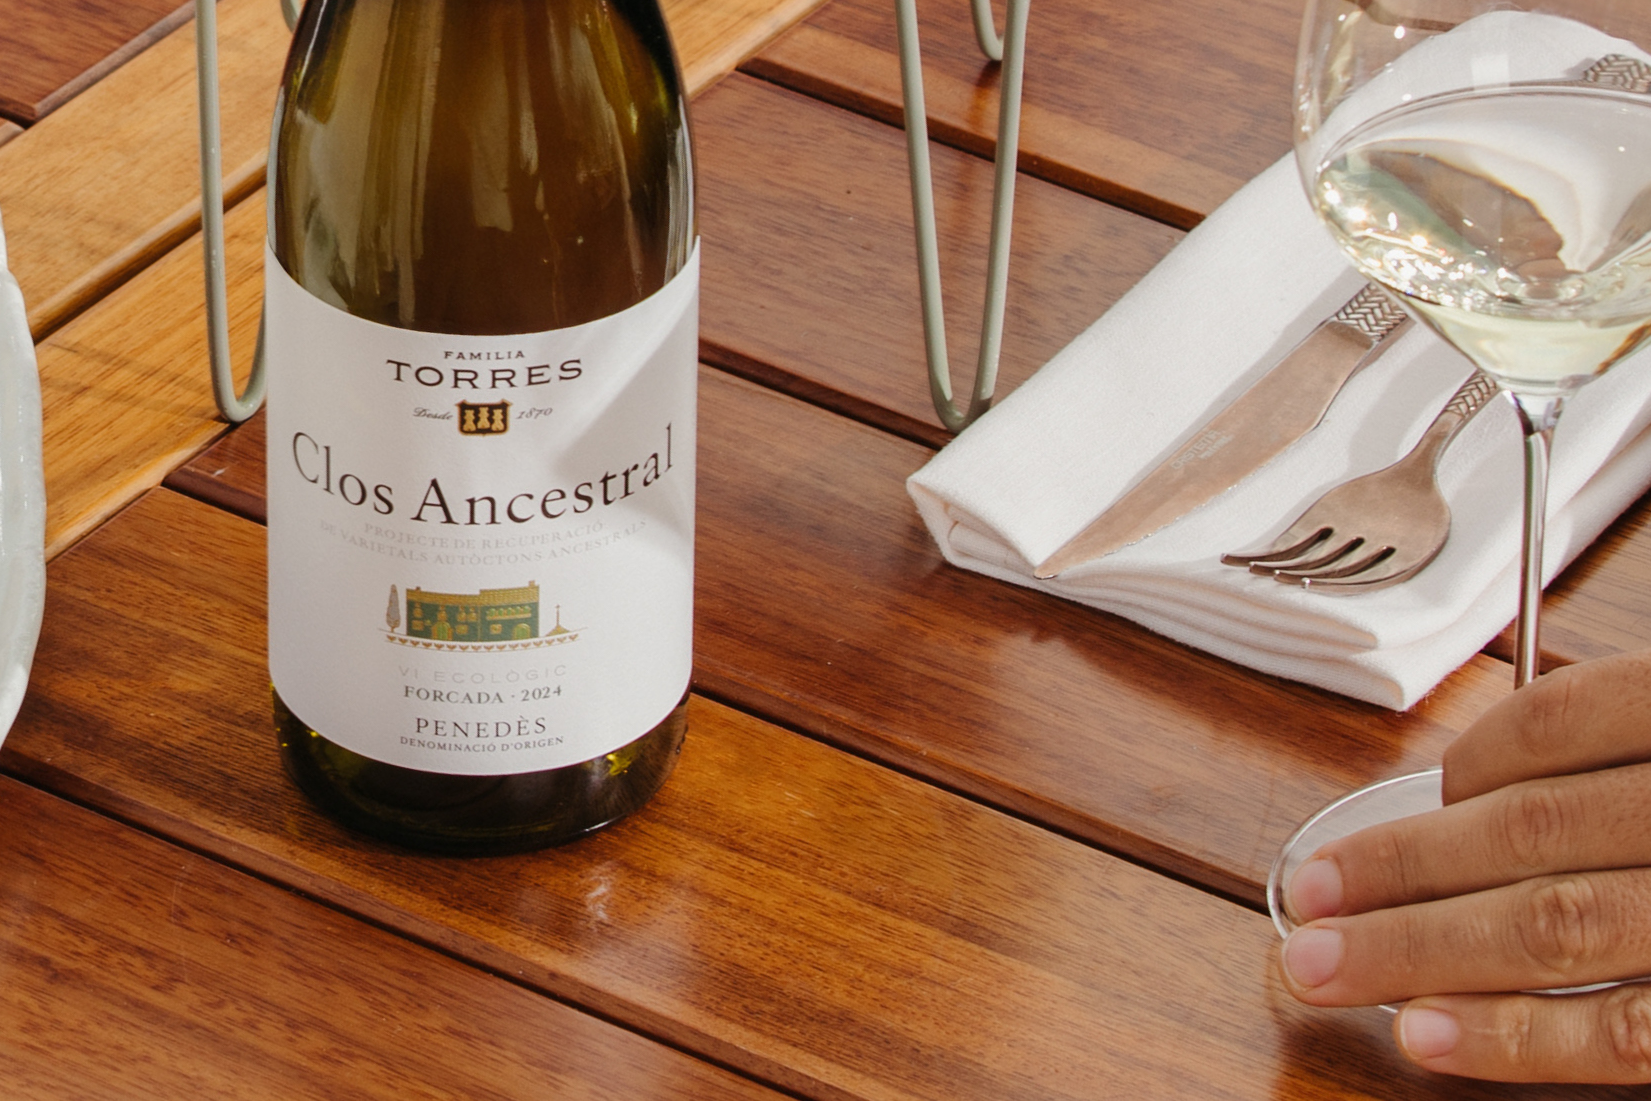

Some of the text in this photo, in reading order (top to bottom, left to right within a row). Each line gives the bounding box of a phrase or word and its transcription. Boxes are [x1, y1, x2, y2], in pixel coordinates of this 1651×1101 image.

[443, 350, 525, 361] FAMILIA
[385, 358, 584, 390] TORRES
[412, 406, 554, 420] Desde 1870
[291, 422, 674, 526] Clos Ancestral
[339, 528, 428, 562] VARIETALS
[547, 518, 647, 560] ANCESTRALS
[363, 519, 604, 549] PROJECTE DE RECUPERACIÓ
[398, 664, 567, 685] VI ECOLÒGIC
[403, 684, 562, 704] FORCADA 2024
[415, 715, 547, 739] PENEDÈS
[399, 735, 565, 753] DENOMINACIÓ D'ORIGEN
